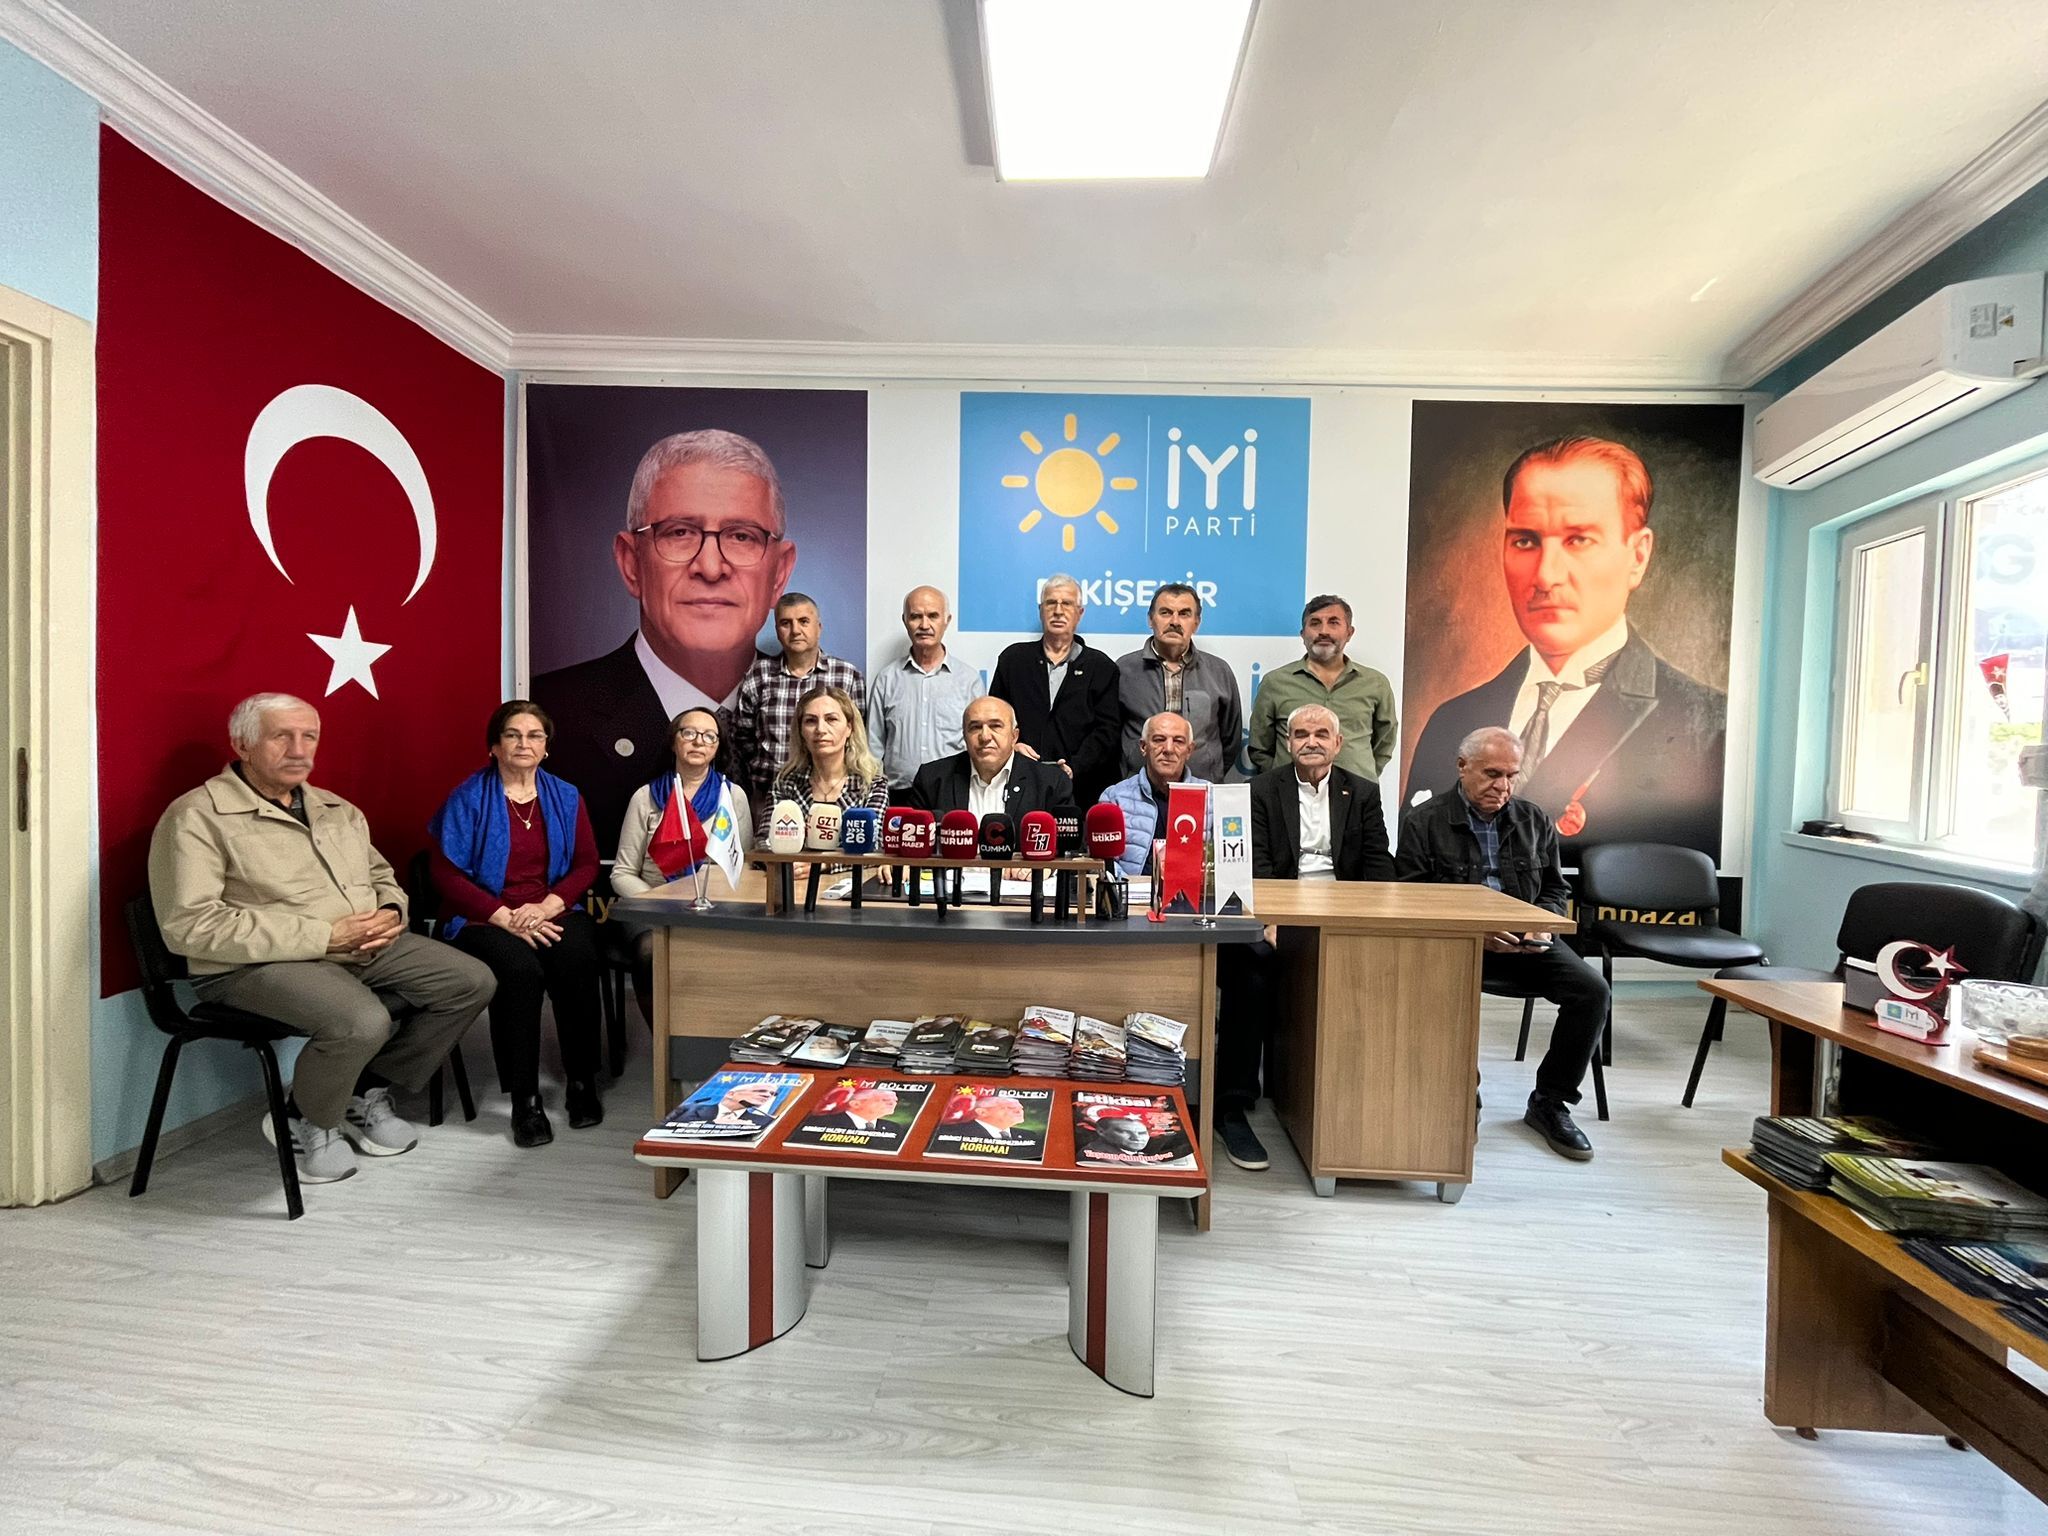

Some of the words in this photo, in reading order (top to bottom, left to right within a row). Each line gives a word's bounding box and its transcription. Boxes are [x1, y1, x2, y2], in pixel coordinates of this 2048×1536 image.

[1166, 427, 1258, 510] İYİ
[1165, 513, 1257, 537] PARTİ
[1036, 570, 1218, 615] KİŞER
[817, 816, 838, 827] GZT
[819, 830, 834, 840] 26
[845, 832, 866, 844] 26
[901, 823, 926, 842] 2E
[820, 1133, 871, 1145] KORKMA!
[959, 1142, 1010, 1155] KORKMA!
